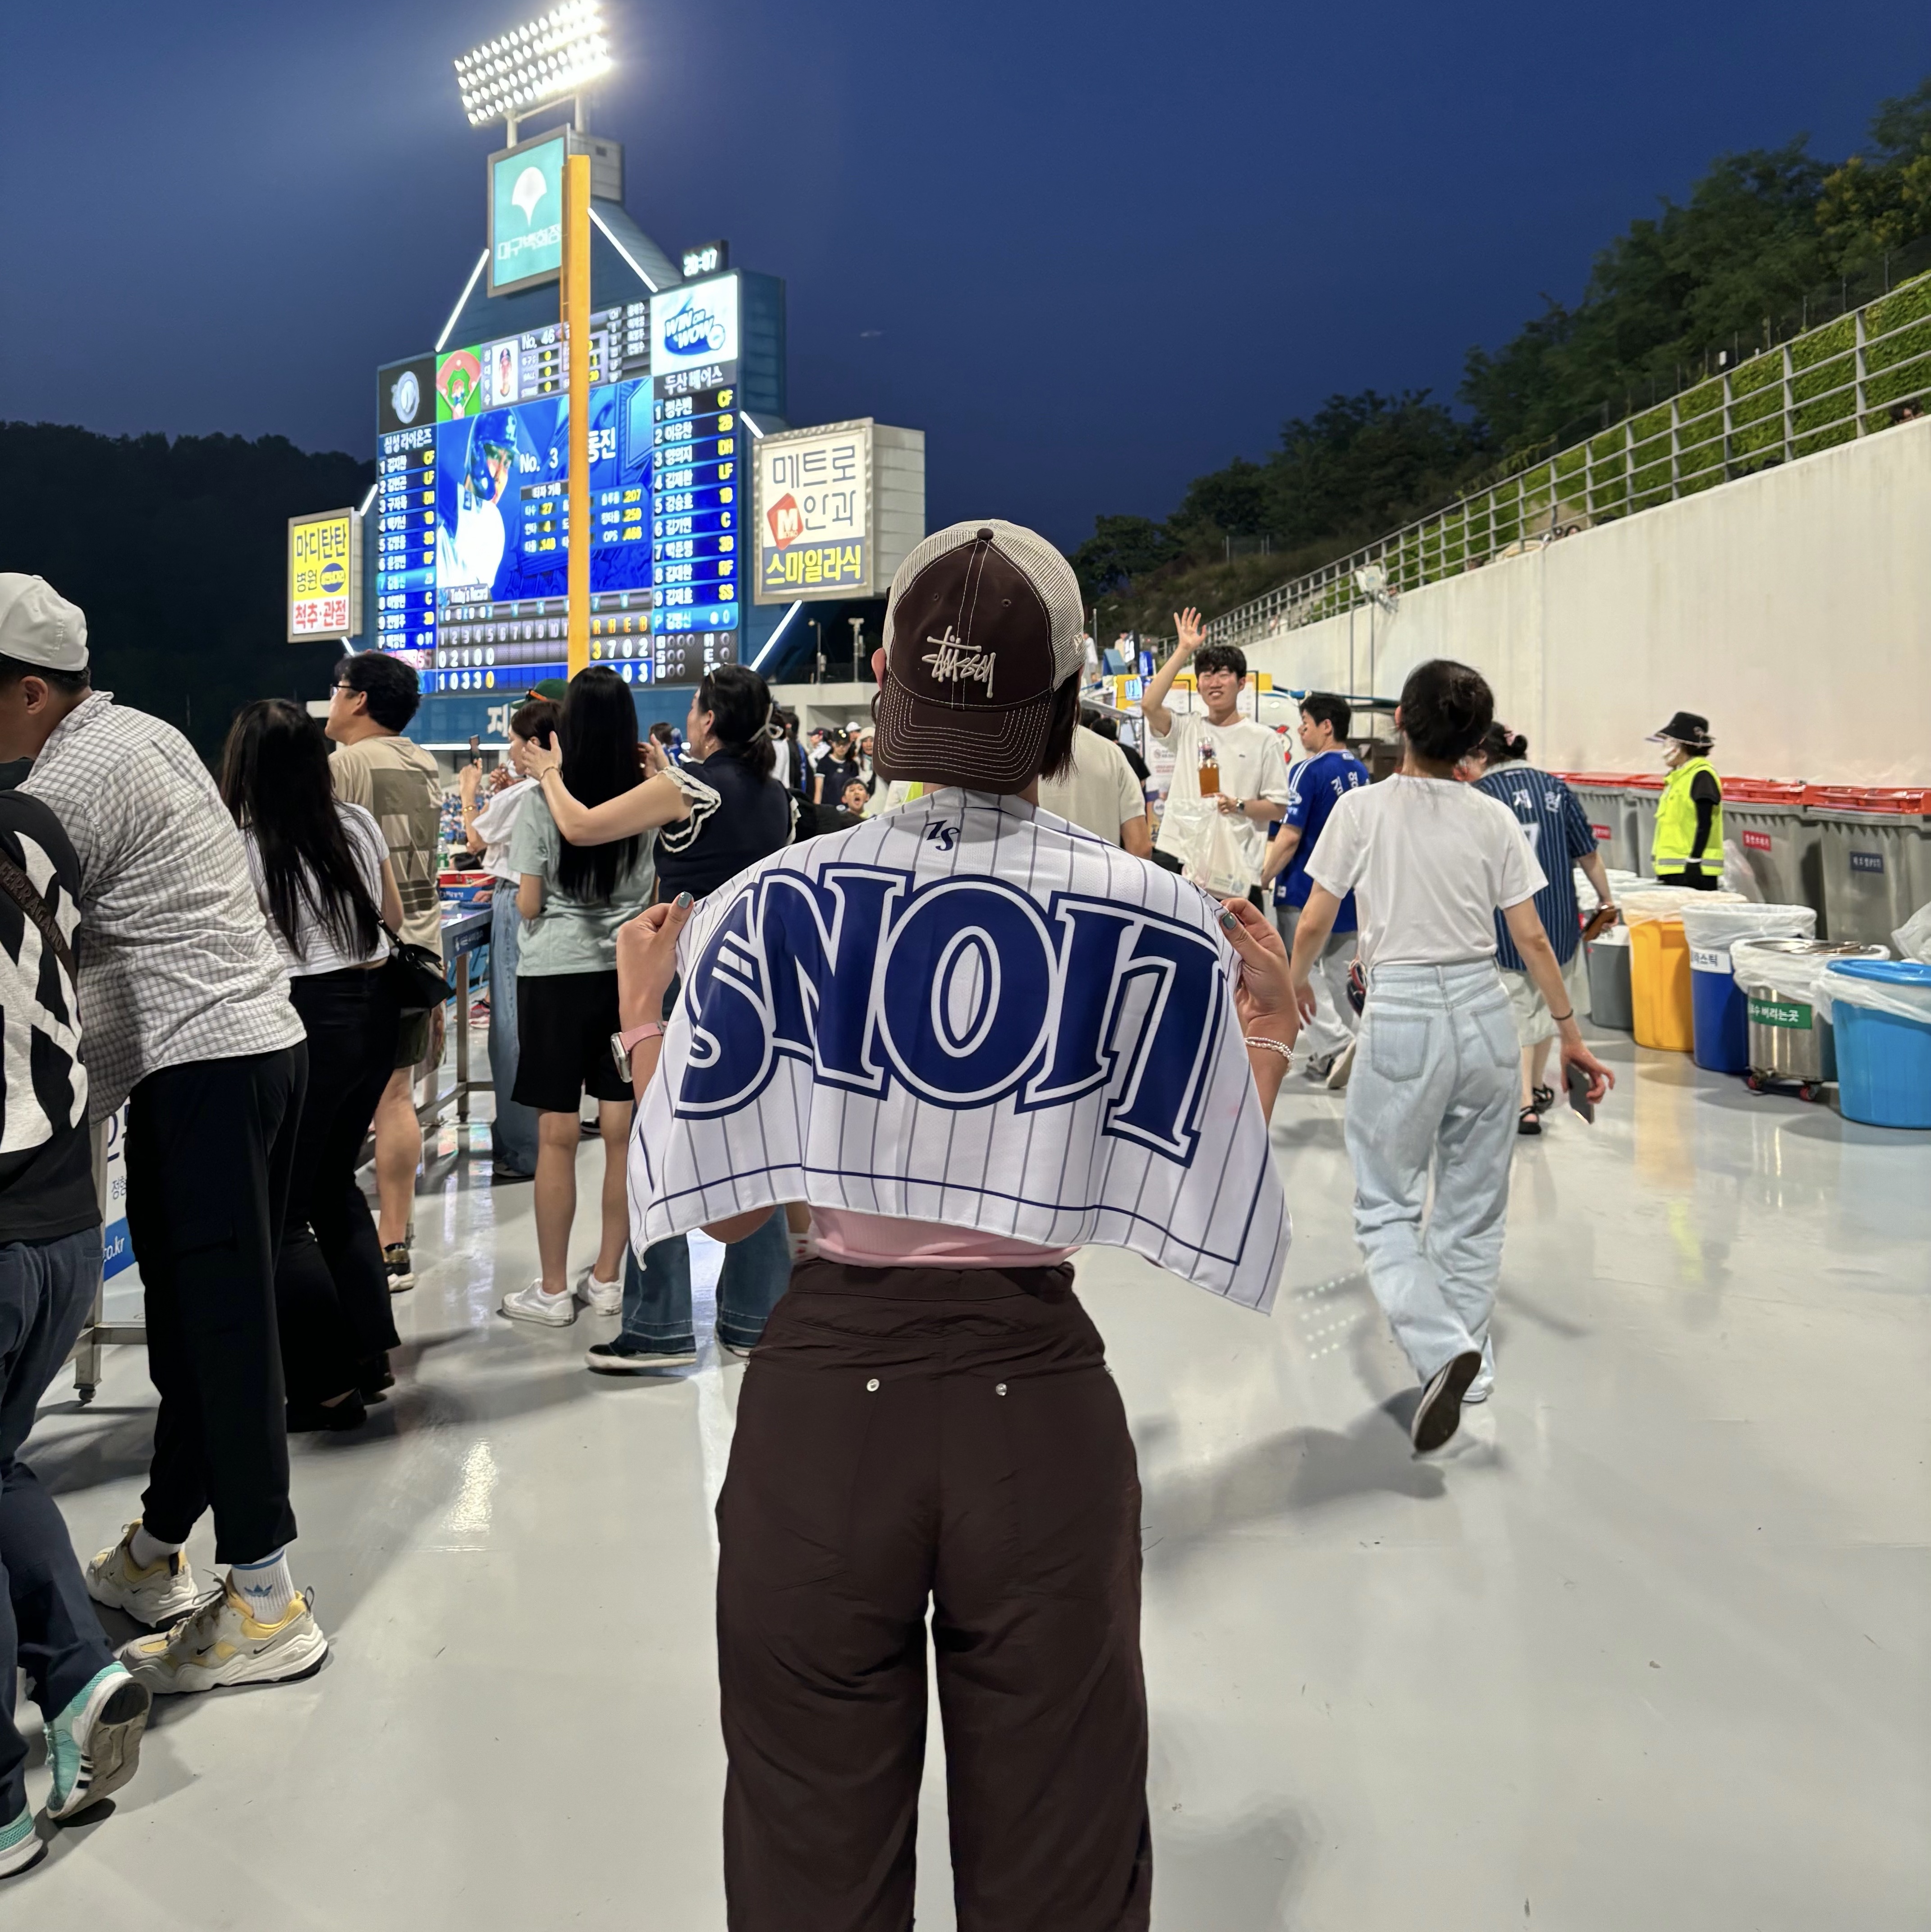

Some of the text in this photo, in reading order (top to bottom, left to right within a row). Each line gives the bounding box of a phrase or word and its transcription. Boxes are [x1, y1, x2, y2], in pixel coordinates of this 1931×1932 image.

[683, 249, 717, 276] 20:07
[665, 309, 693, 337] WIN
[522, 335, 537, 350] No.
[541, 328, 555, 344] 46
[664, 365, 723, 395] 두산 베어스
[655, 405, 661, 420] 1
[718, 390, 733, 408] CF
[385, 428, 432, 454] 삼성 라이온즈
[655, 428, 662, 444] 2
[665, 421, 693, 441] 이유찬
[380, 461, 385, 474] 1
[423, 450, 435, 465] CF
[520, 453, 540, 473] No.
[549, 447, 558, 468] 3
[654, 451, 662, 467] 3
[665, 445, 692, 465] 양의지
[773, 445, 856, 488] 메트로
[380, 480, 385, 494] 2
[423, 470, 435, 485] LF
[654, 474, 662, 490] 4
[718, 463, 733, 480] LF
[380, 500, 385, 513] 3
[541, 502, 553, 515] 27
[655, 497, 662, 514] 5
[803, 490, 856, 531] 안과
[379, 519, 385, 532] 4
[603, 530, 618, 542] OPS
[655, 521, 663, 537] 6
[721, 512, 731, 528] C
[296, 523, 346, 563] 마디탄탄
[379, 538, 385, 551] 5
[655, 544, 663, 560] 7
[379, 558, 385, 571] 6
[655, 568, 663, 583] 8
[766, 545, 861, 585] 스마일라식
[297, 569, 317, 593] 병원
[380, 575, 385, 590] 7
[379, 597, 385, 610] 8
[425, 592, 432, 605] C
[655, 591, 663, 606] 9
[719, 584, 734, 600] SS
[379, 616, 385, 629] 9
[440, 631, 445, 645] 1
[452, 631, 458, 644] 2
[463, 630, 469, 644] 3
[475, 629, 481, 642] 4
[487, 627, 494, 642] 5
[500, 626, 506, 641] 6
[513, 625, 518, 640] 7
[550, 623, 559, 638] 10
[624, 617, 631, 633] E
[704, 633, 714, 647] H
[439, 651, 446, 668] 0
[450, 650, 459, 667] 2
[462, 649, 469, 666] 1
[473, 648, 482, 666] 0
[486, 647, 495, 665] 0
[592, 640, 601, 660] 3
[607, 639, 616, 659] 7
[623, 638, 633, 658] 0
[638, 638, 648, 657] 2
[656, 648, 714, 664] S E
[439, 663, 648, 690] 1 0 3 3 0 0 3
